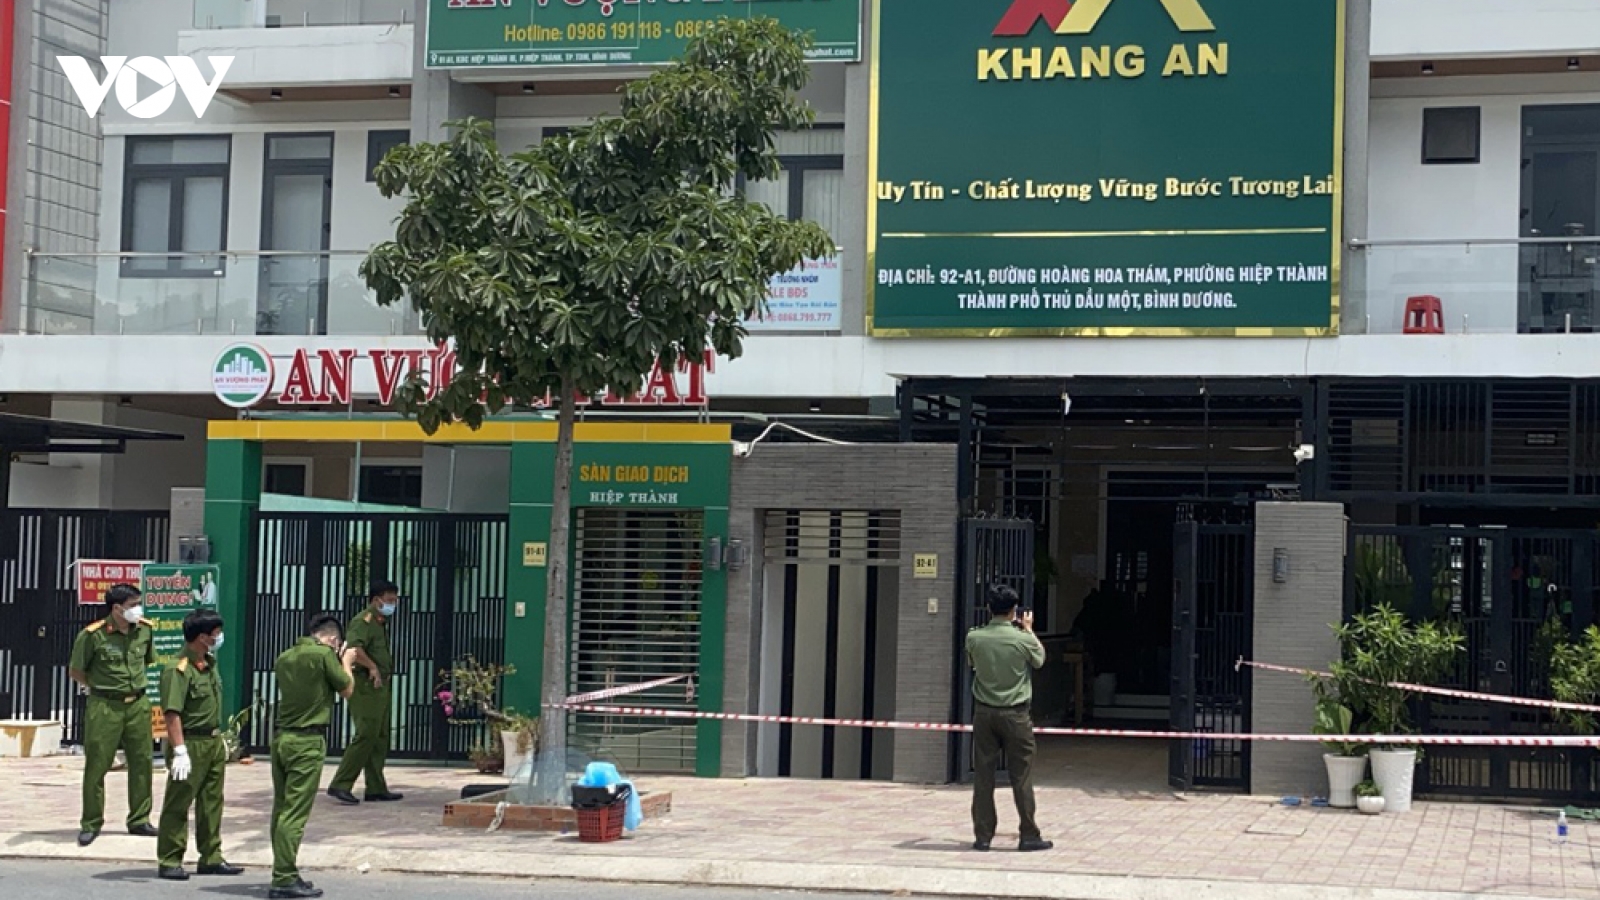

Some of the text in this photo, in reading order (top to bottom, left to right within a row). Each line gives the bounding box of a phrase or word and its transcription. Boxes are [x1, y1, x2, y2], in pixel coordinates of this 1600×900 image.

[504, 23, 564, 42] Hotline:
[567, 22, 606, 40] 0986
[976, 43, 1229, 80] KHANG AN
[877, 174, 1334, 203] Uy Tín - Chất Lượng Vững Bước Tương Lai
[878, 261, 1328, 287] ĐỊA CHỈ: 92-A1, ĐƯỜNG HOÀNG HOA THÁM, PHƯỜNG HIỆP THÀNH
[958, 287, 1238, 312] THÀNH PHỐ THỦ DẦU MỘT, BÌNH DƯƠNG.
[278, 348, 357, 404] AN
[579, 461, 689, 485] SÀN GIAO DỊCH
[589, 489, 678, 505] HIỆP THÀNH
[82, 563, 102, 579] NHÀ
[103, 566, 124, 579] CHO
[145, 569, 191, 590] TUYỂN
[145, 592, 194, 609] DỤNG!
